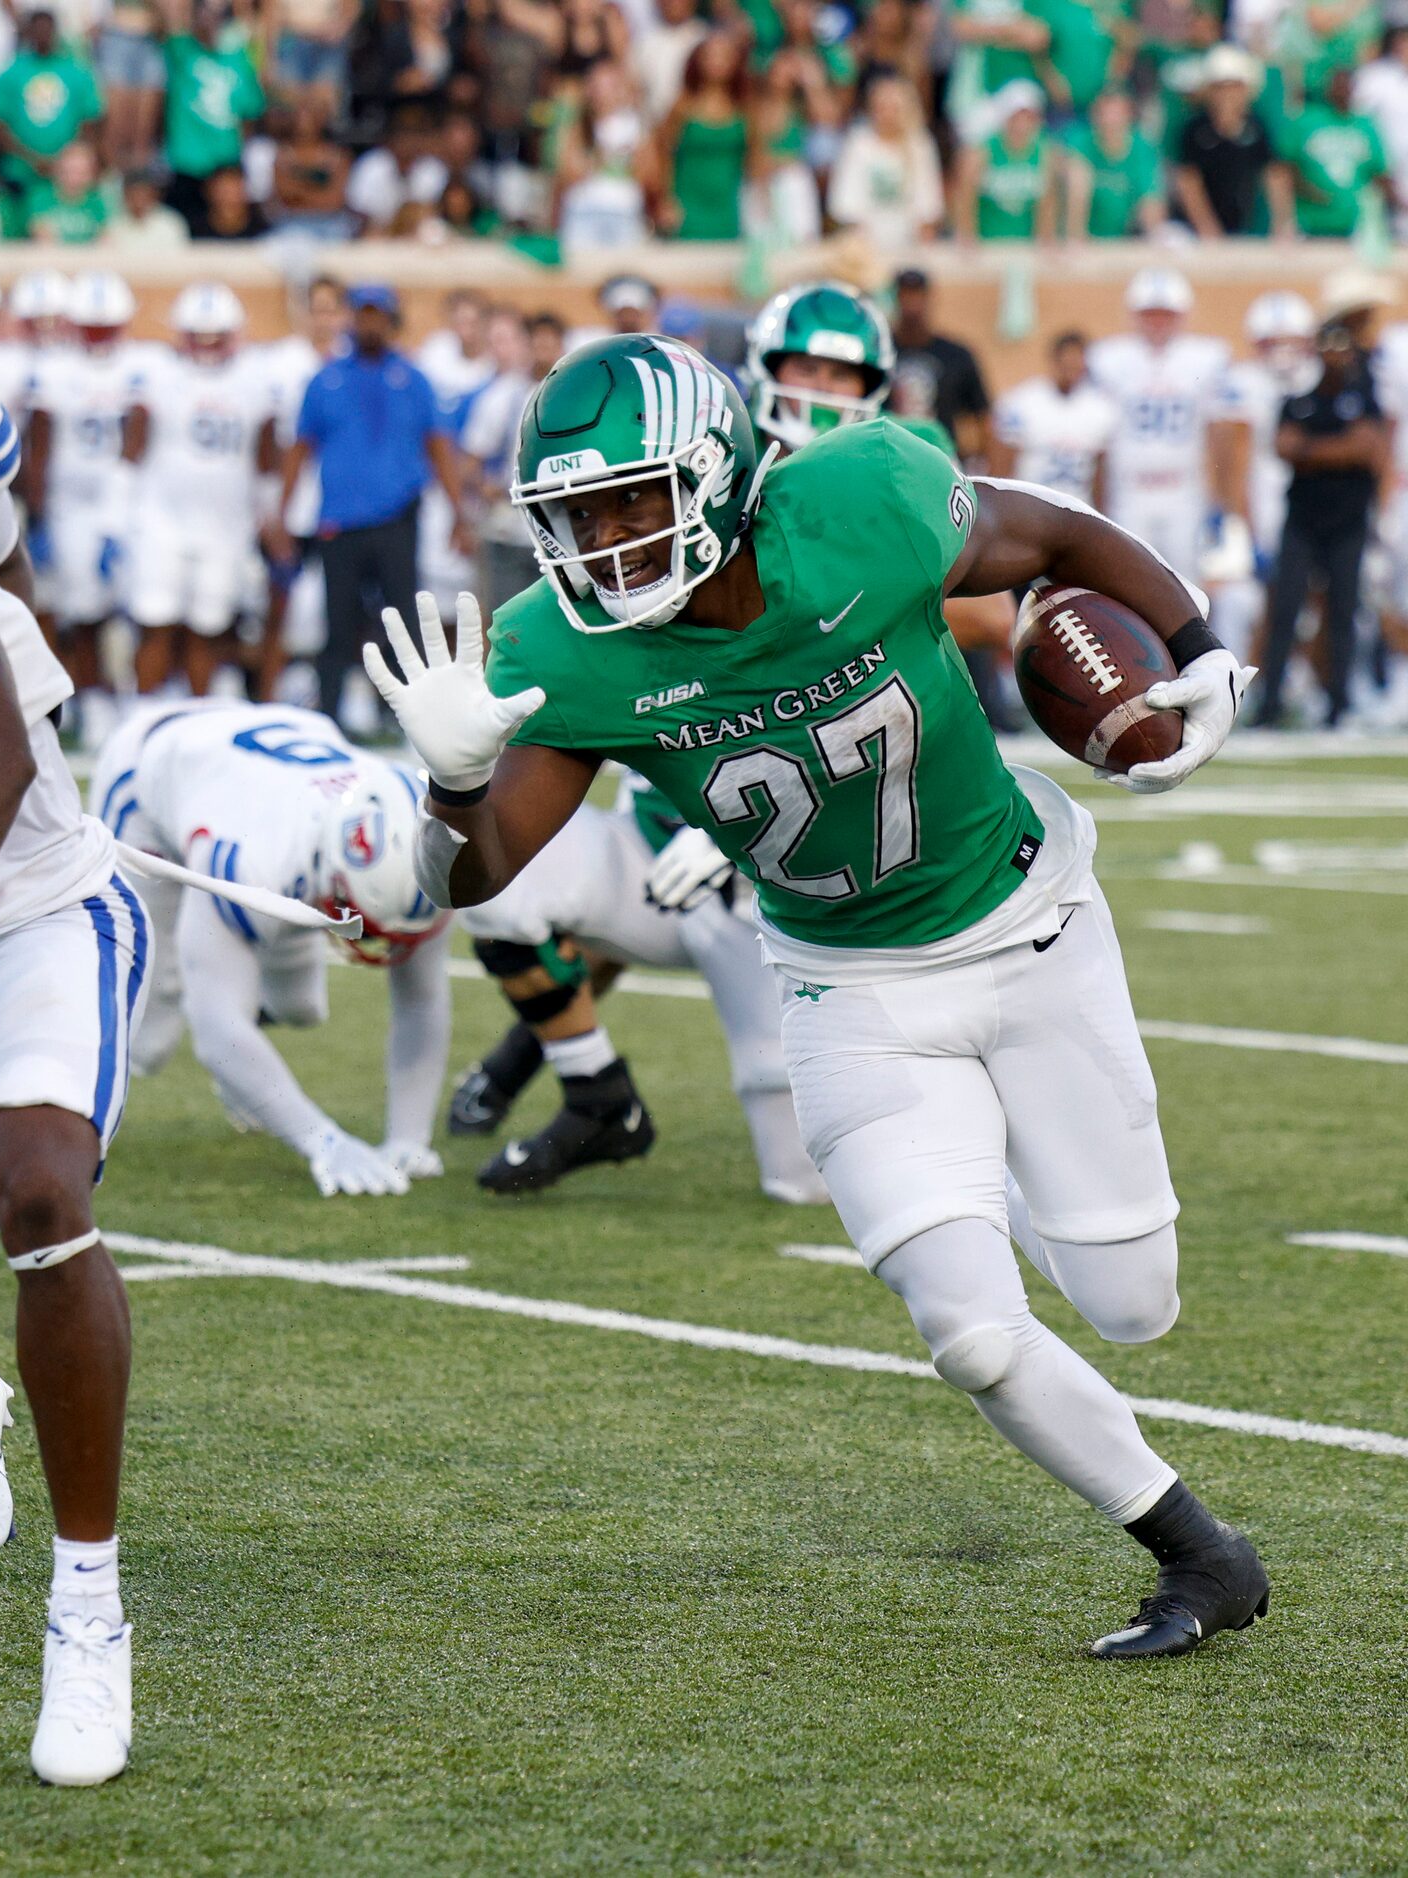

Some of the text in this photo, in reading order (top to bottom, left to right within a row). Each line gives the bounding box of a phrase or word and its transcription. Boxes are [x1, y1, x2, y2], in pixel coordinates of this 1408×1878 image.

[548, 454, 583, 474] UNT
[654, 643, 889, 751] MEAN GREEN
[701, 668, 923, 902] 27
[1019, 844, 1034, 861] M
